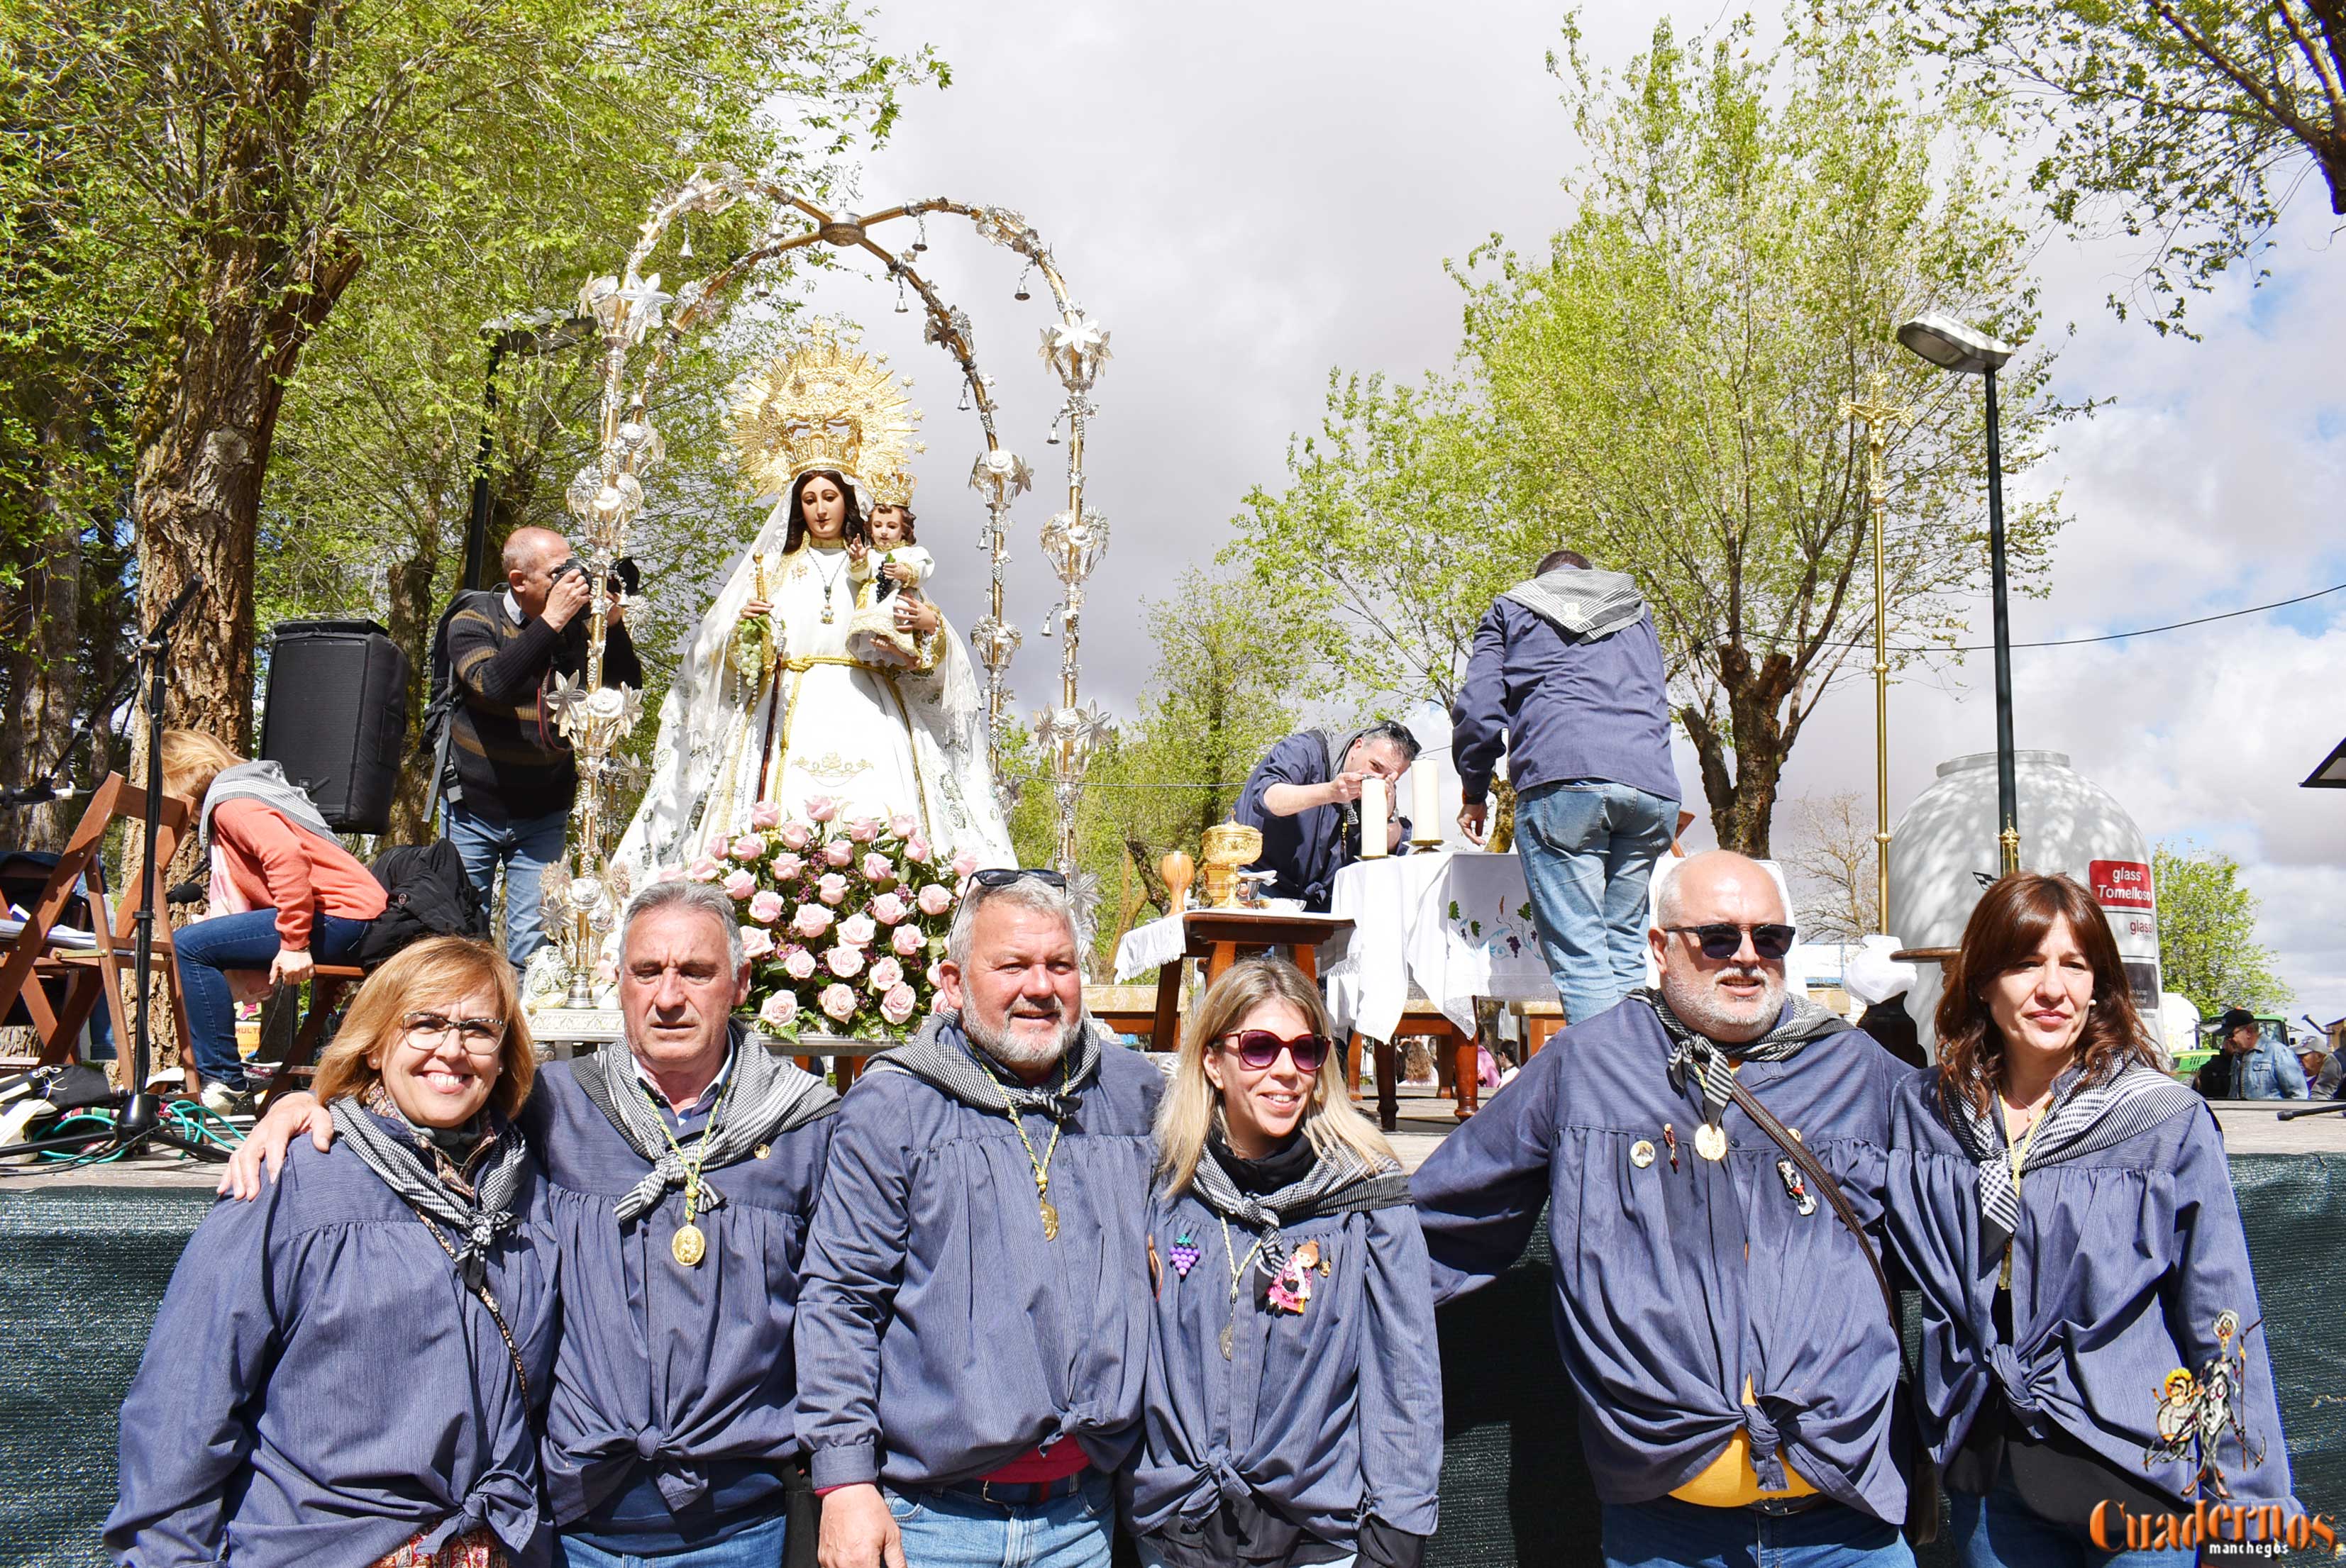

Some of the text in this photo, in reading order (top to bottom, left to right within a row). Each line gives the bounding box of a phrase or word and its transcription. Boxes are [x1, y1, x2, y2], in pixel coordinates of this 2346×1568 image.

[2113, 867, 2142, 883] glass
[2097, 884, 2151, 901] Tomelloso
[2130, 919, 2152, 935] glass
